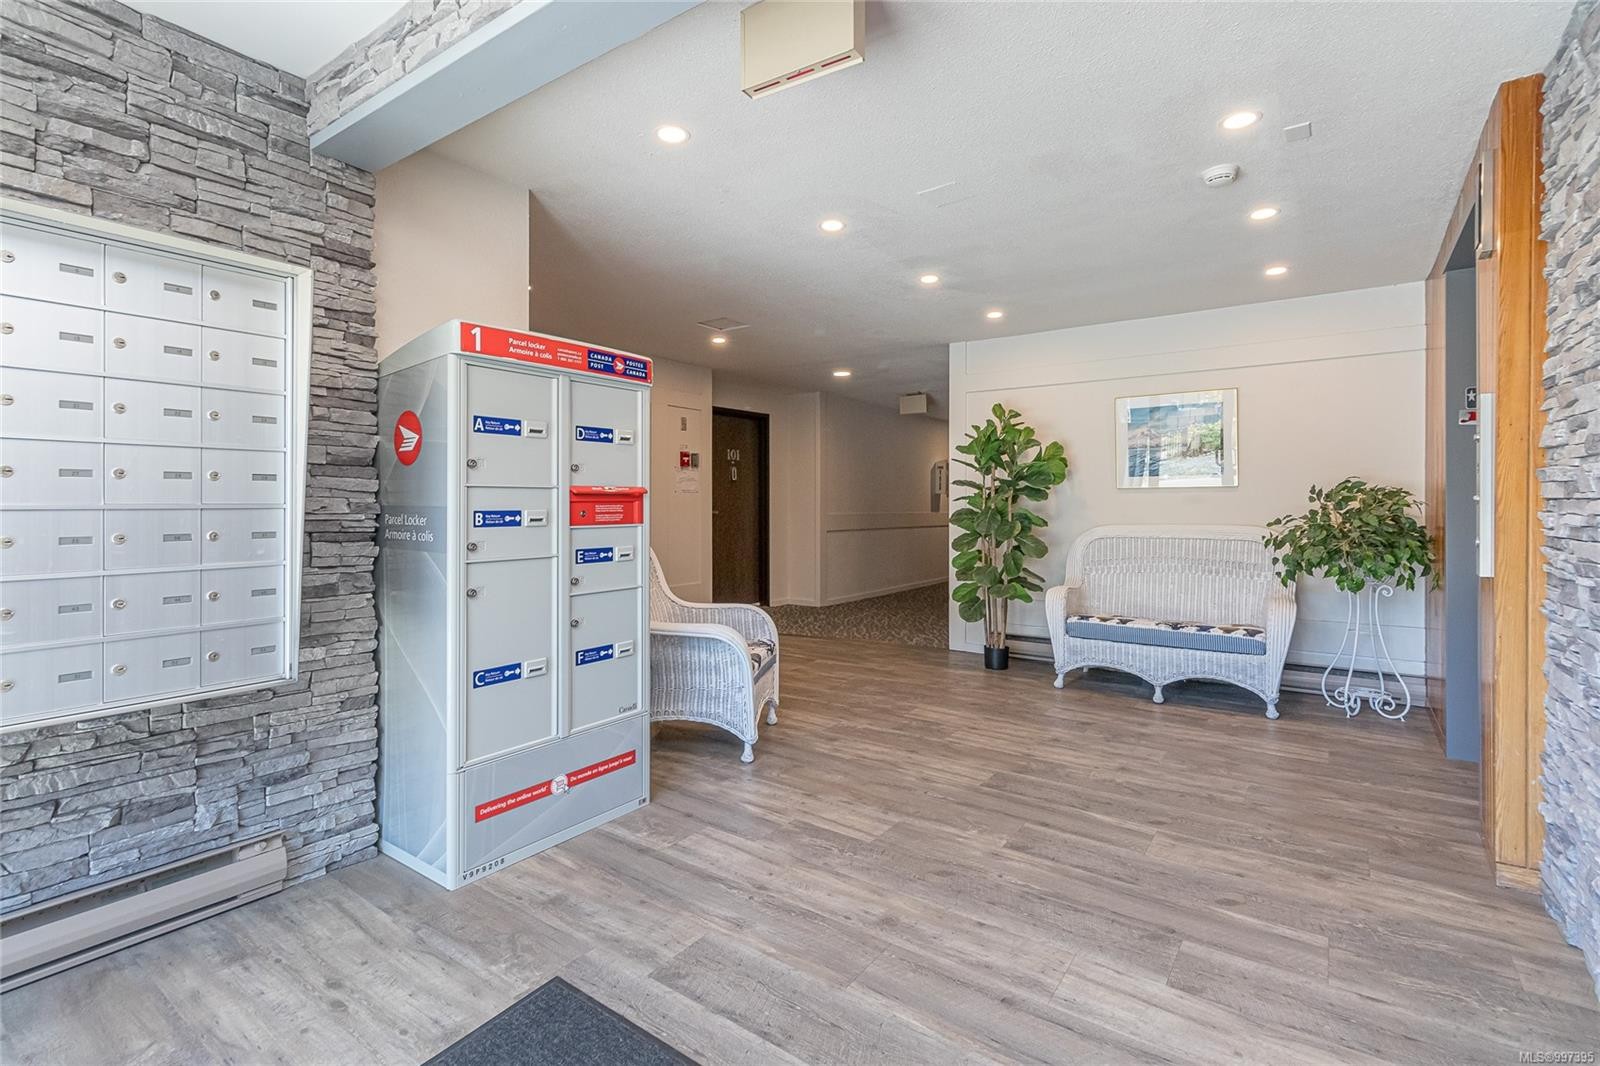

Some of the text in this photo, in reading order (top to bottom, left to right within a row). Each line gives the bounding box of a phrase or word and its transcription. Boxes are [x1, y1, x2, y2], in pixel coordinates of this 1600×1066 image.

[470, 327, 481, 351] 1
[508, 337, 528, 347] Parcel
[508, 346, 534, 357] Armoire
[539, 351, 553, 360] colis
[590, 353, 612, 362] CANADA
[626, 361, 644, 369] POSTES
[626, 369, 646, 377] CANADA
[474, 418, 485, 431] A
[576, 427, 585, 440] D
[727, 449, 740, 461] 101
[384, 513, 427, 526] Parcel Locker
[475, 513, 483, 526] B
[384, 529, 434, 542] Armoire à colis
[577, 551, 584, 563] E
[577, 651, 584, 664] F
[475, 672, 485, 686] C
[480, 801, 507, 816] Delivering
[507, 797, 516, 805] the
[516, 792, 532, 802] online
